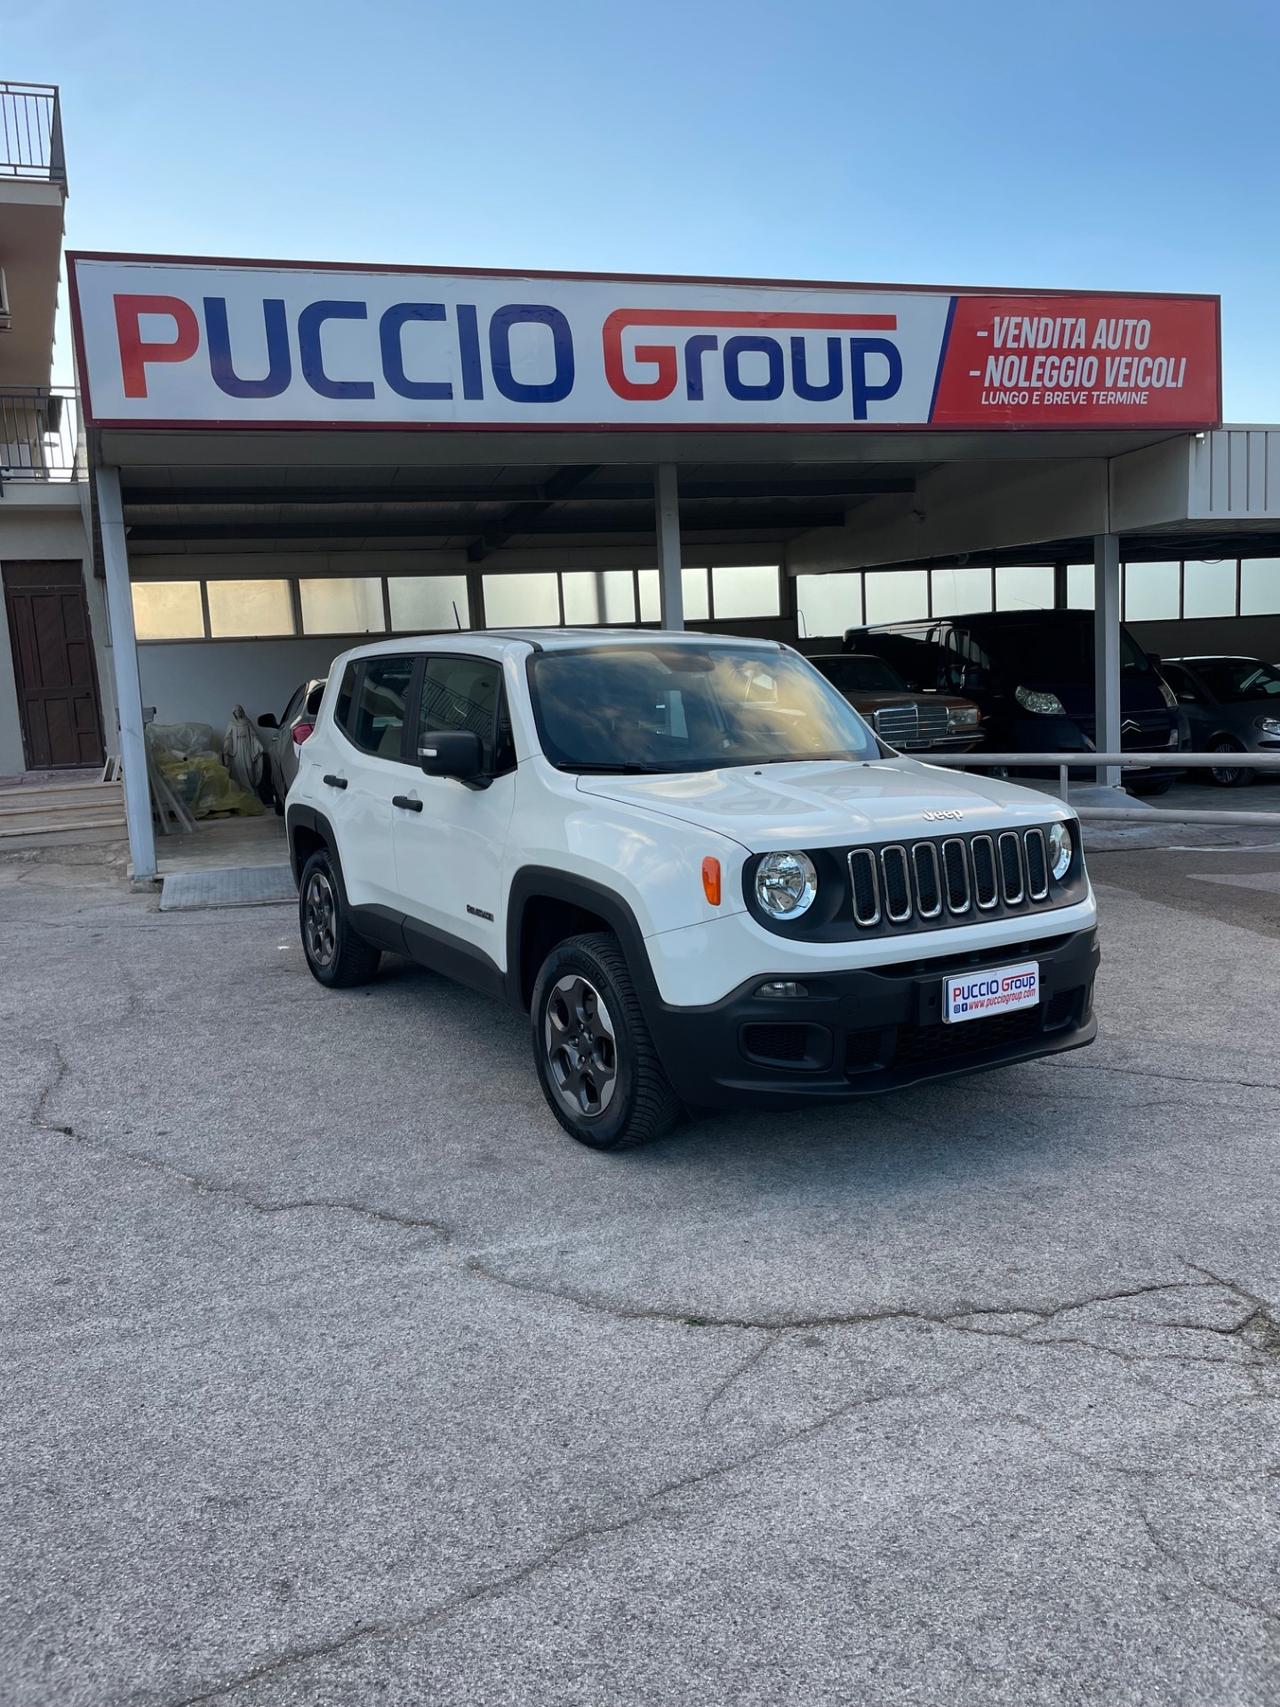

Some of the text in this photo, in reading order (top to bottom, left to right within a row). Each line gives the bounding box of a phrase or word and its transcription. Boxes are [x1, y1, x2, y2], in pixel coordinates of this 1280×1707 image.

[1091, 318, 1151, 350] AUTO
[113, 294, 575, 403] PUCCIO
[1104, 356, 1187, 388] VEICOLI
[981, 391, 1150, 405] LUNGO E BREVE TERMINE
[922, 808, 964, 822] Jeep
[953, 980, 1000, 1002] PUCCIO
[968, 988, 1037, 1010] www.pucciogroup.com
